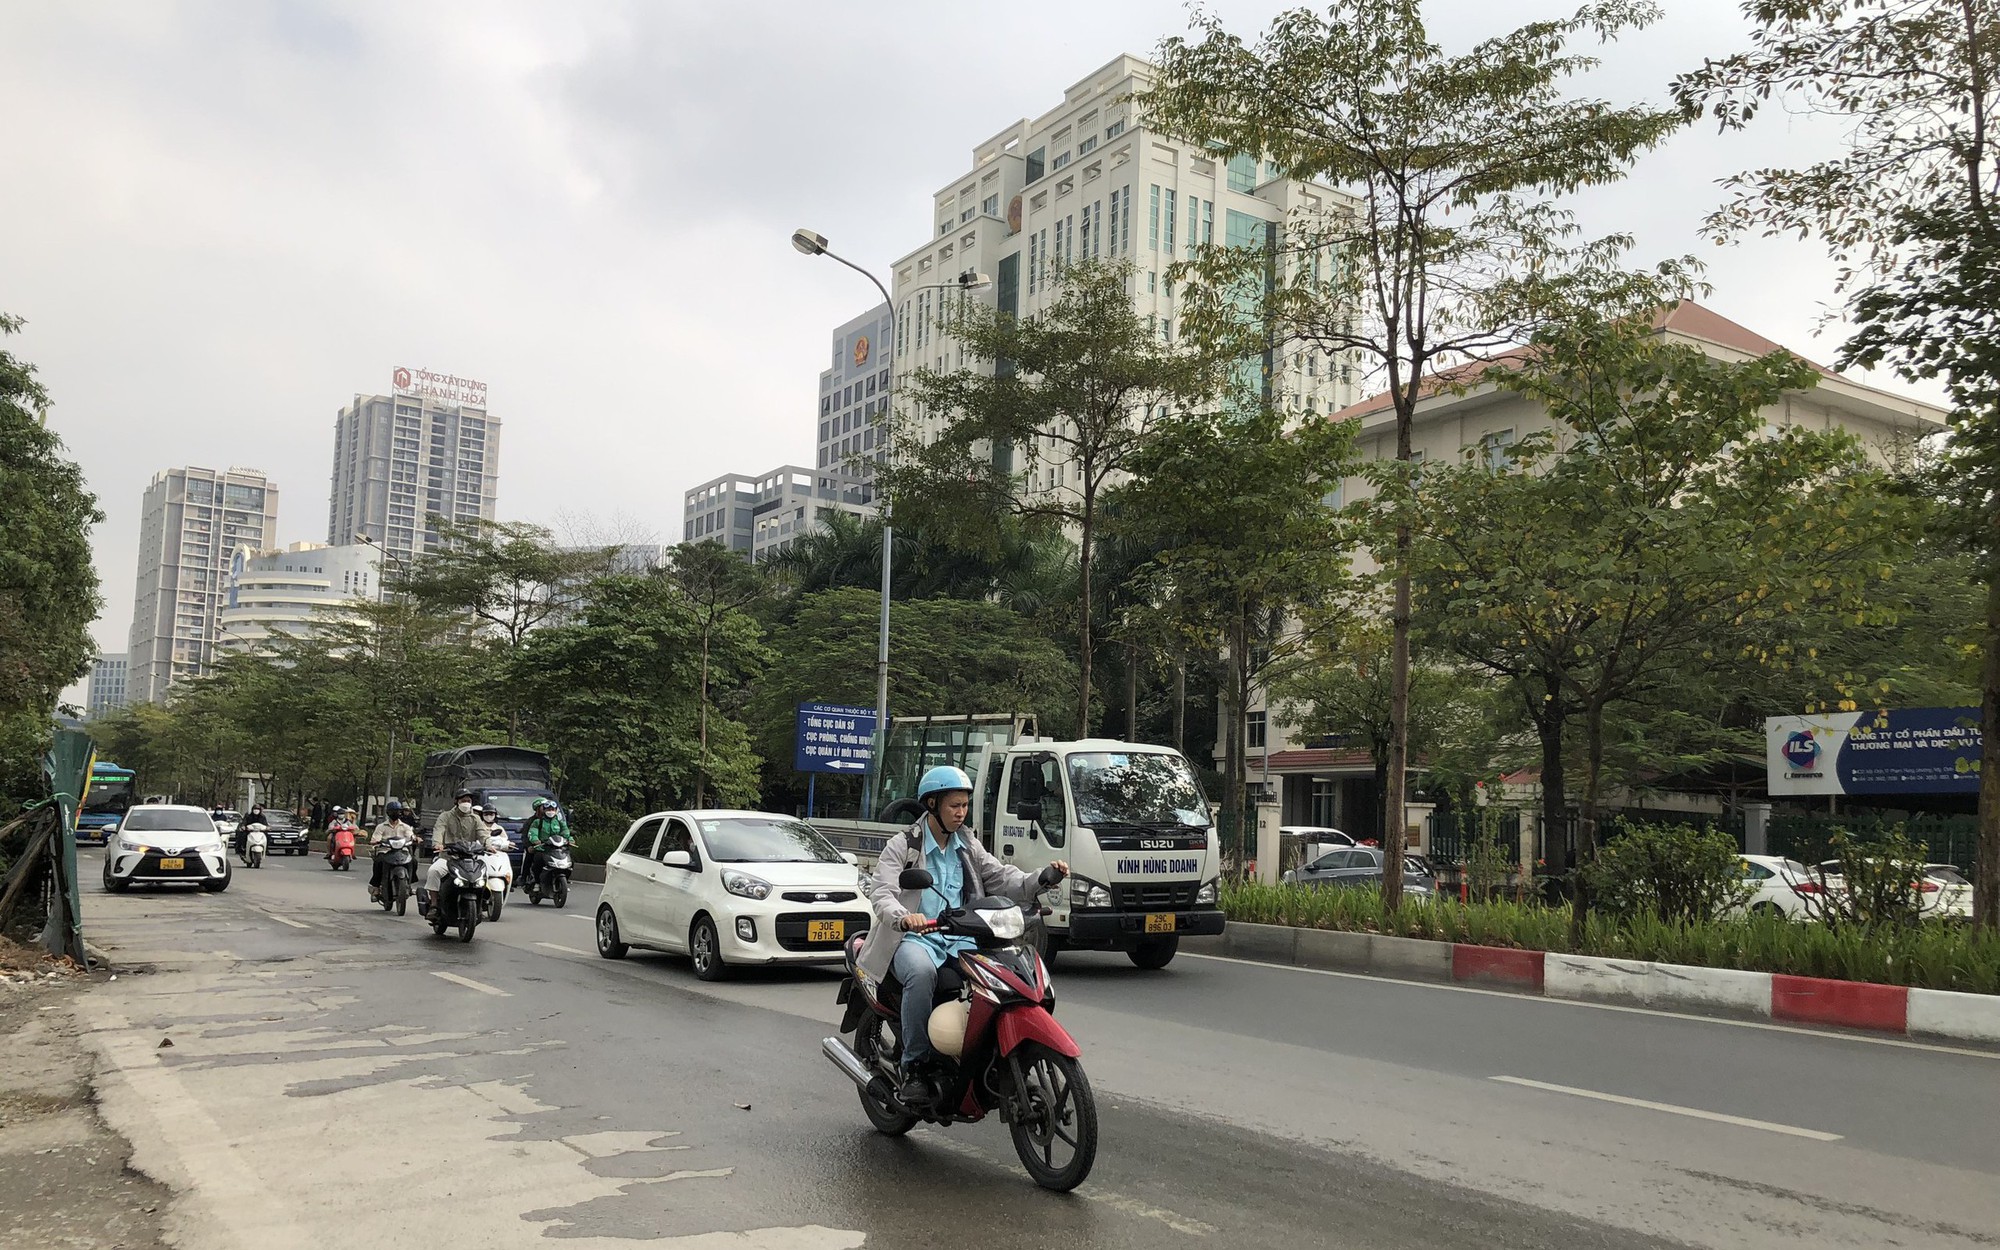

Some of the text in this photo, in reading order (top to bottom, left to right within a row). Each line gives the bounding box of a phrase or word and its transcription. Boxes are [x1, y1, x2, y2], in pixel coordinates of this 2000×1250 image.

[415, 367, 487, 391] TỔNG XÂY DỰNG
[414, 383, 487, 405] THANH HÓA
[822, 719, 834, 730] CỤC
[847, 718, 855, 730] SỐ
[806, 732, 817, 742] CỤC
[1880, 732, 1893, 740] TY
[1895, 728, 1910, 739] CỔ
[1789, 740, 1814, 753] ILS
[1893, 741, 1912, 750] MẠI
[1914, 739, 1928, 748] VÀ
[805, 745, 817, 756] CỤC
[833, 746, 840, 757] LÝ
[1140, 840, 1174, 848] ISUZU
[1117, 856, 1198, 874] KÍNH HÙNG DOANH
[1154, 915, 1167, 923] 29C
[819, 921, 834, 931] 30E
[812, 931, 841, 940] 781.62
